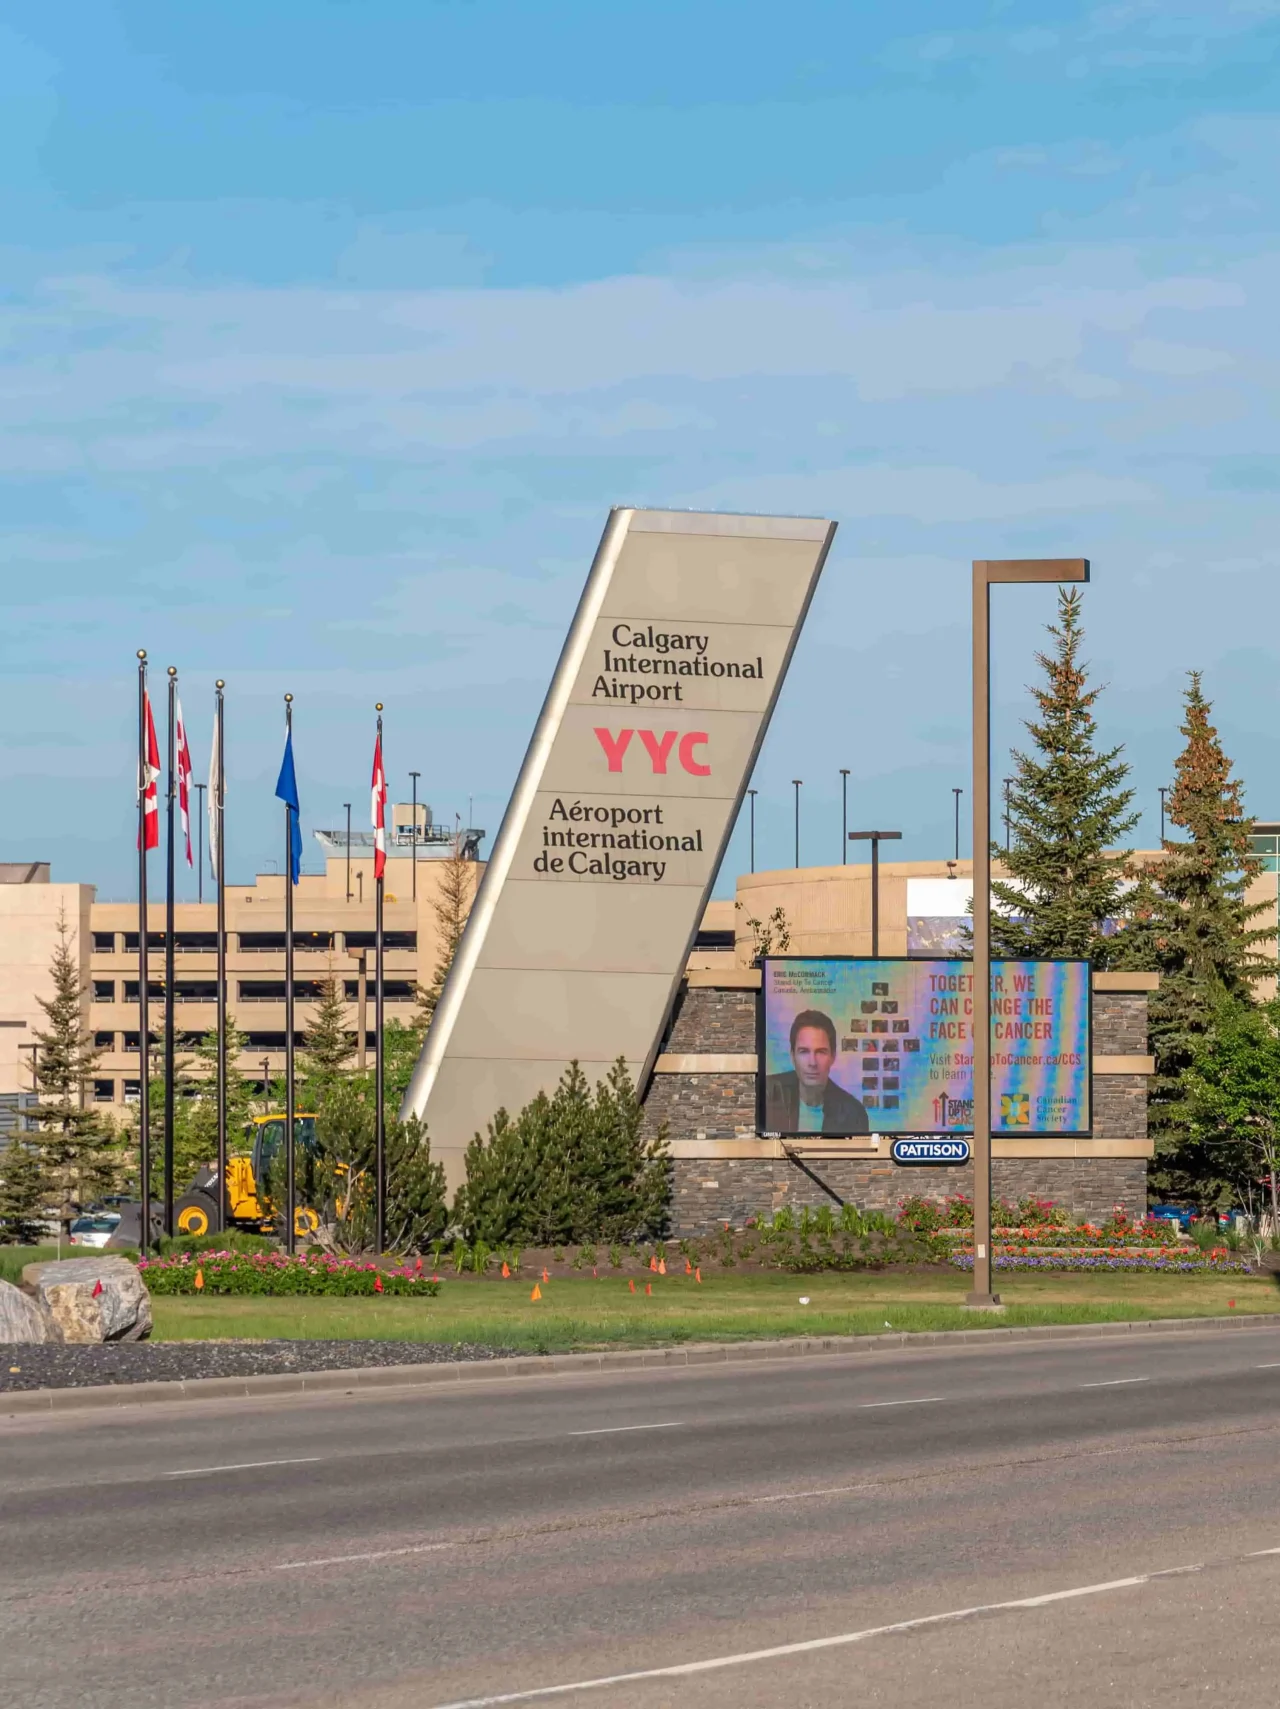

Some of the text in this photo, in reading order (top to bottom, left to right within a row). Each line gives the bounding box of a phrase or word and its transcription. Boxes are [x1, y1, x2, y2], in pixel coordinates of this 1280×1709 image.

[612, 624, 709, 655] Calgary
[603, 650, 764, 679] International
[592, 675, 683, 704] Airport
[593, 727, 712, 777] YYC
[549, 798, 664, 828] Aéroport
[543, 826, 703, 852] international
[533, 850, 667, 882] de Calgary
[929, 975, 1035, 994] TOGETR, WE
[930, 998, 1053, 1015] CAN CNGE THE
[930, 1022, 966, 1039] FACE
[995, 1022, 1053, 1039] CANCER
[930, 1053, 951, 1065] Visit
[900, 1143, 963, 1156] PATTISON
